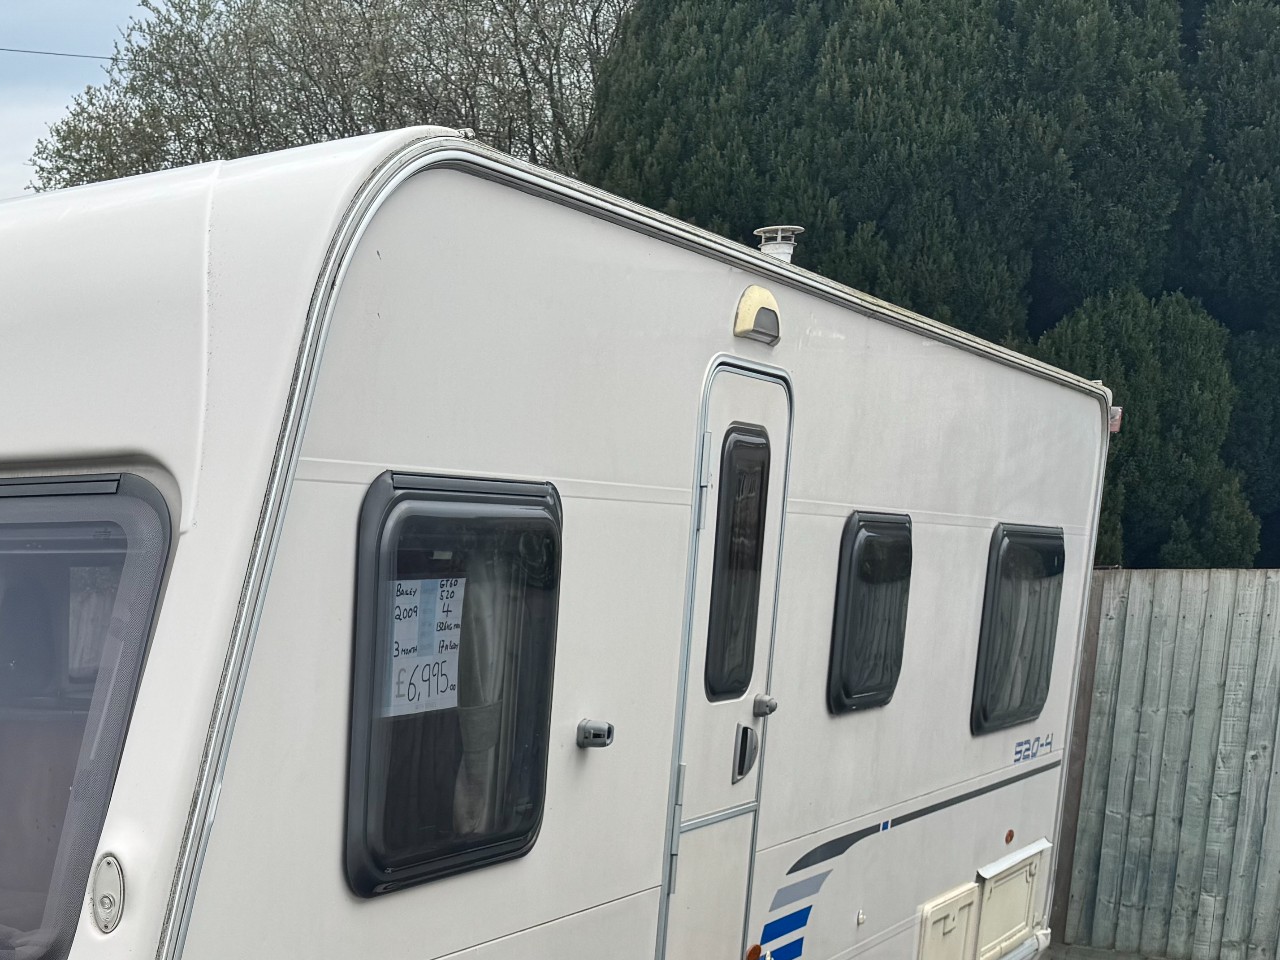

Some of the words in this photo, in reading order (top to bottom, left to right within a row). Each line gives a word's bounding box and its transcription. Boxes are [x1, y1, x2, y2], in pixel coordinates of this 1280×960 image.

[440, 590, 455, 600] 520
[395, 605, 418, 621] 2009
[442, 602, 452, 617] 4
[394, 641, 400, 657] 3
[1013, 732, 1053, 762] 520-4
